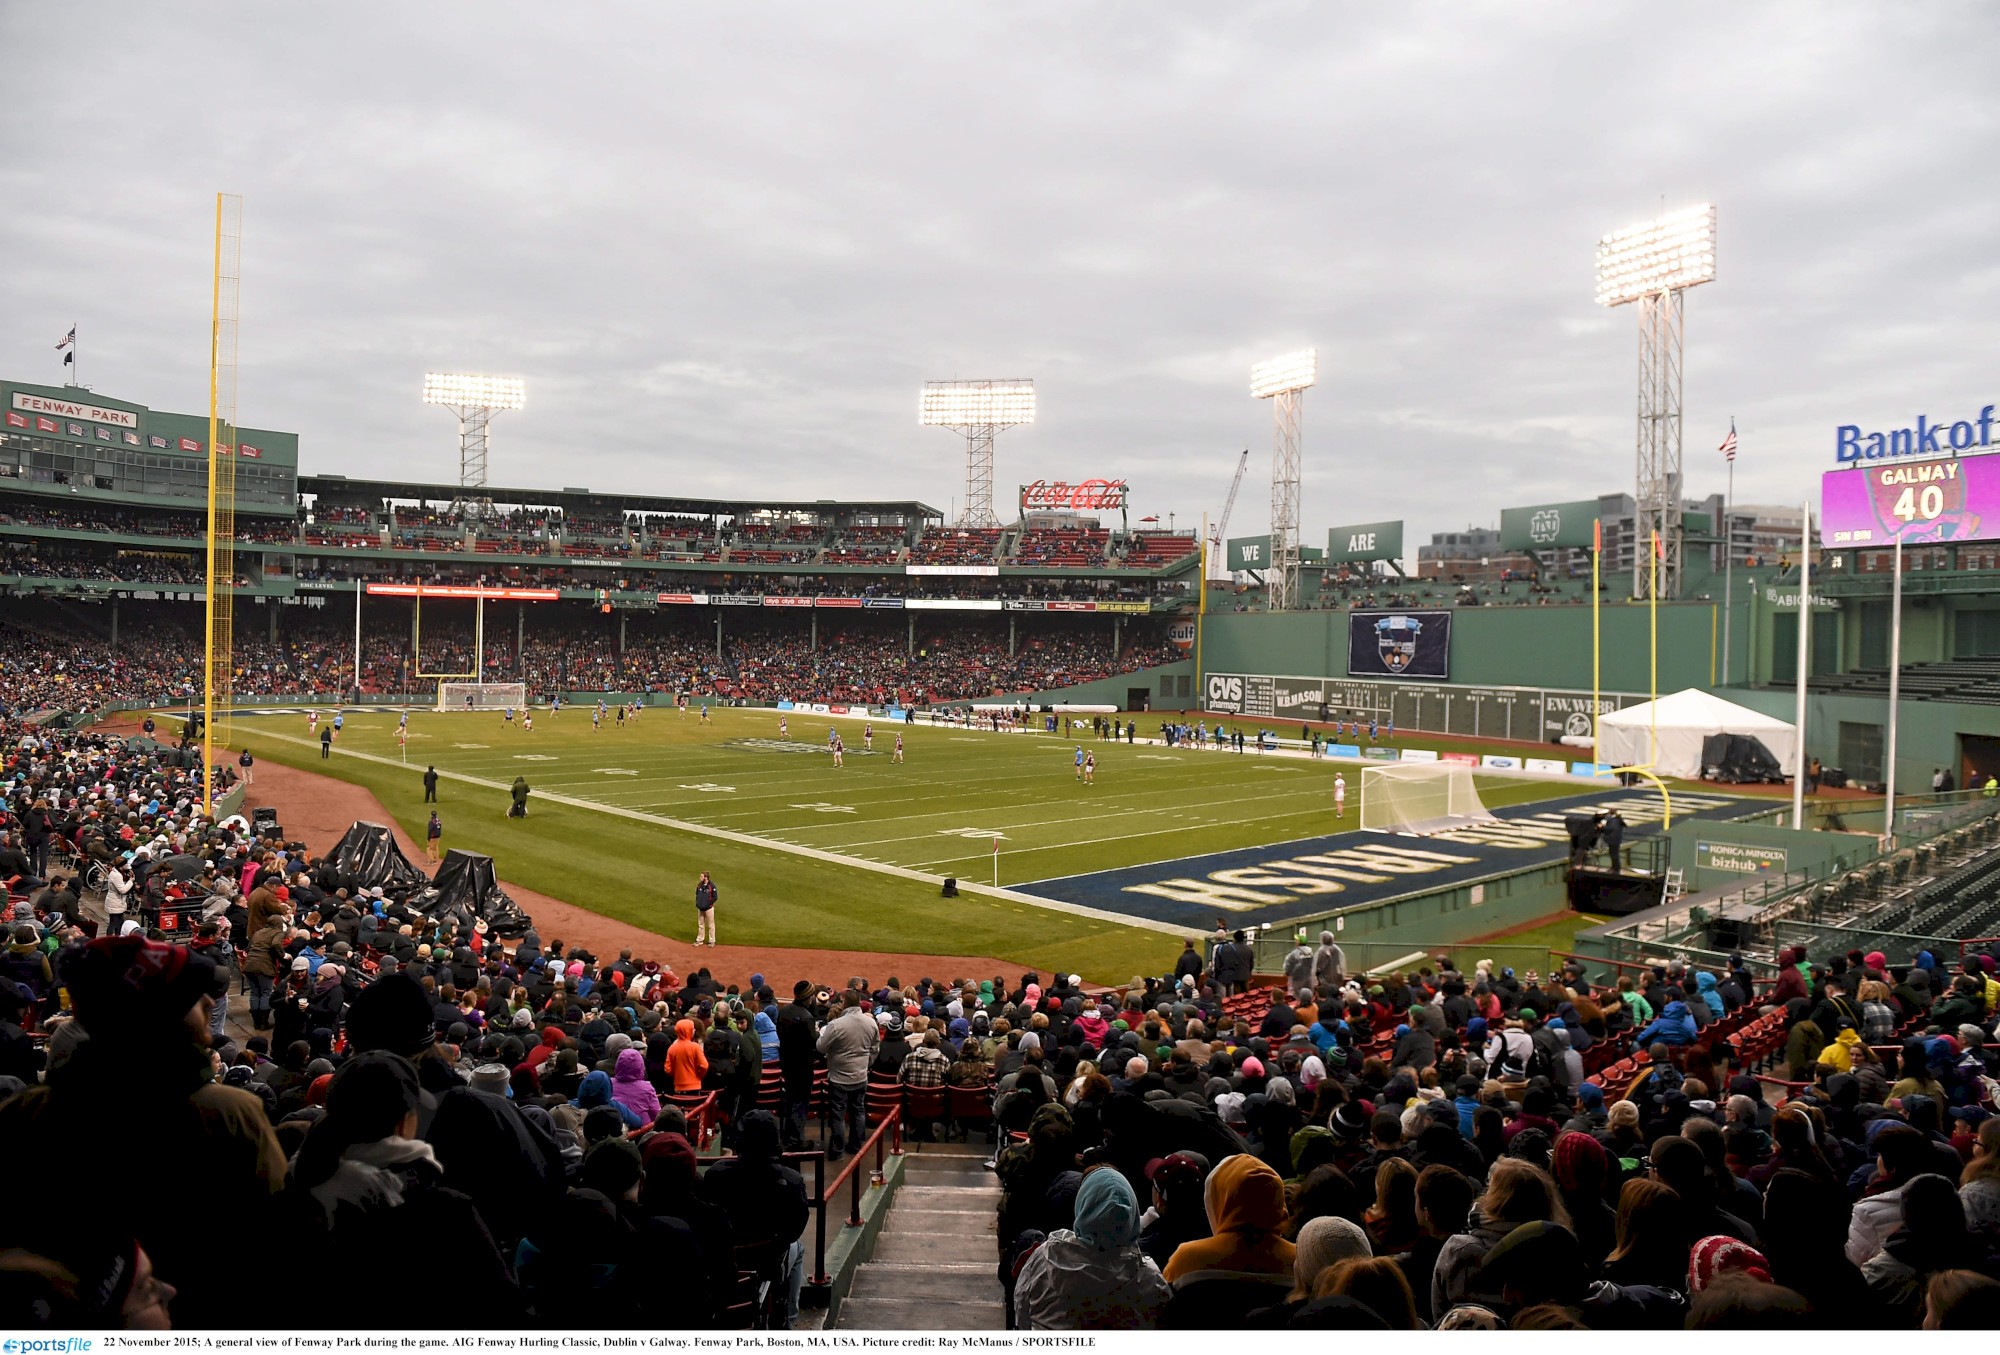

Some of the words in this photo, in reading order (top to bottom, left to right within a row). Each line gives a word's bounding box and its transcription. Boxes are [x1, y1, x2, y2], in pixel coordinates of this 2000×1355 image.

[21, 397, 83, 416] FENWAY
[91, 409, 129, 424] PARK
[1836, 415, 1942, 463] Bank
[1949, 405, 1995, 451] of
[1881, 463, 1959, 486] GALWAY
[1022, 478, 1126, 509] Coca-Cola
[1893, 485, 1944, 521] 40
[1348, 533, 1376, 552] ARE
[1242, 545, 1259, 561] WE
[1007, 601, 1024, 609] Tribe
[1776, 594, 1837, 606] ABIME
[1169, 625, 1194, 639] Gulf
[1209, 676, 1242, 701] CVS
[1209, 698, 1241, 712] pharmacy
[1427, 794, 1736, 849] FIGHING
[1710, 845, 1744, 857] KONICA
[1745, 848, 1785, 861] MINOLTA
[1711, 856, 1757, 871] bizhub
